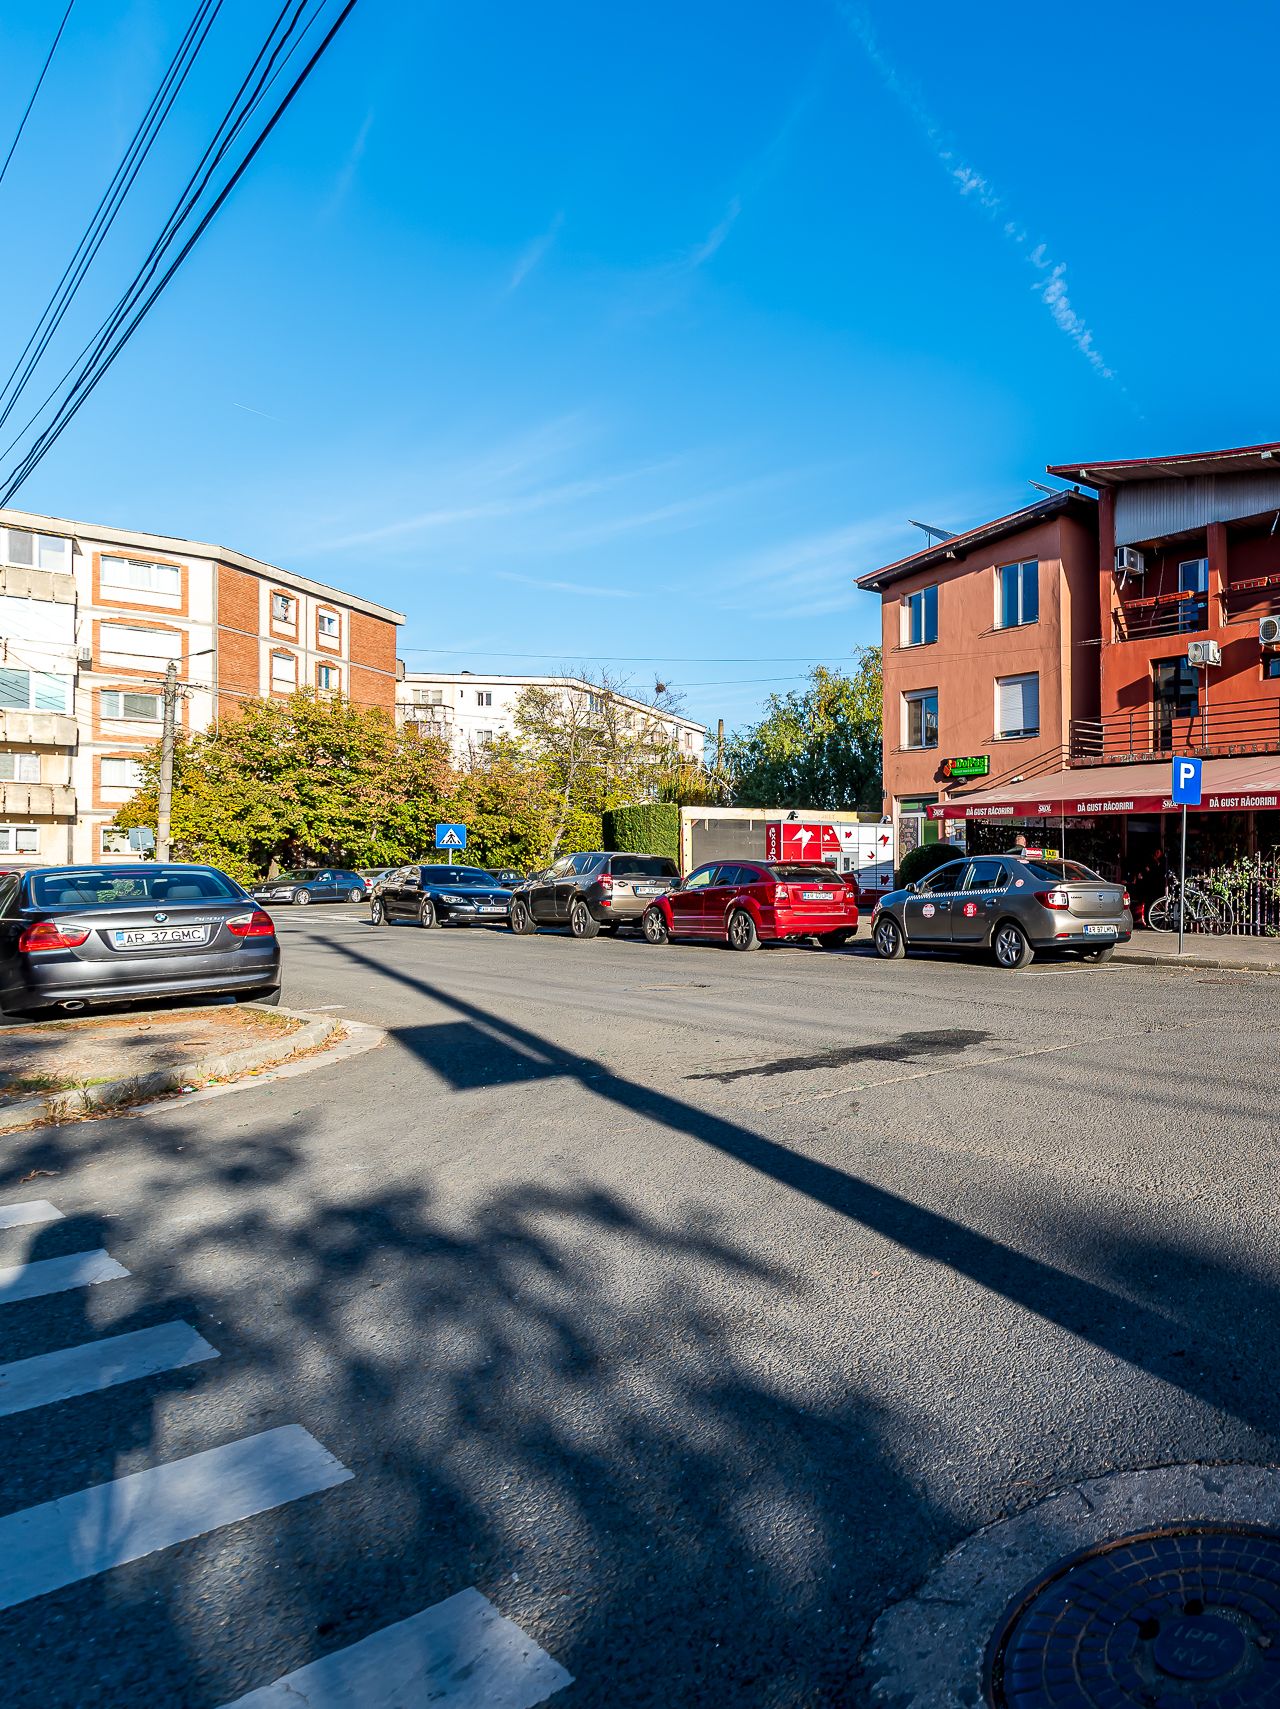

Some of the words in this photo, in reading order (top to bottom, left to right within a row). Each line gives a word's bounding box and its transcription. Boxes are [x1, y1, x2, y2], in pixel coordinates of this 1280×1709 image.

[1179, 762, 1195, 789] P
[1077, 802, 1085, 812] DĂ
[1087, 802, 1102, 812] GUST
[1103, 801, 1134, 811] RĂCORIRII
[1209, 796, 1219, 807] DĂ
[1221, 798, 1239, 807] GUST
[1240, 795, 1277, 807] RĂCORIRII
[966, 807, 974, 816] DĂ
[974, 807, 987, 816] GUST
[988, 806, 1014, 815] RĂCORIRII
[1038, 804, 1051, 813] SKOL
[126, 933, 145, 944] AR
[151, 932, 168, 942] 37
[171, 930, 201, 941] GMC
